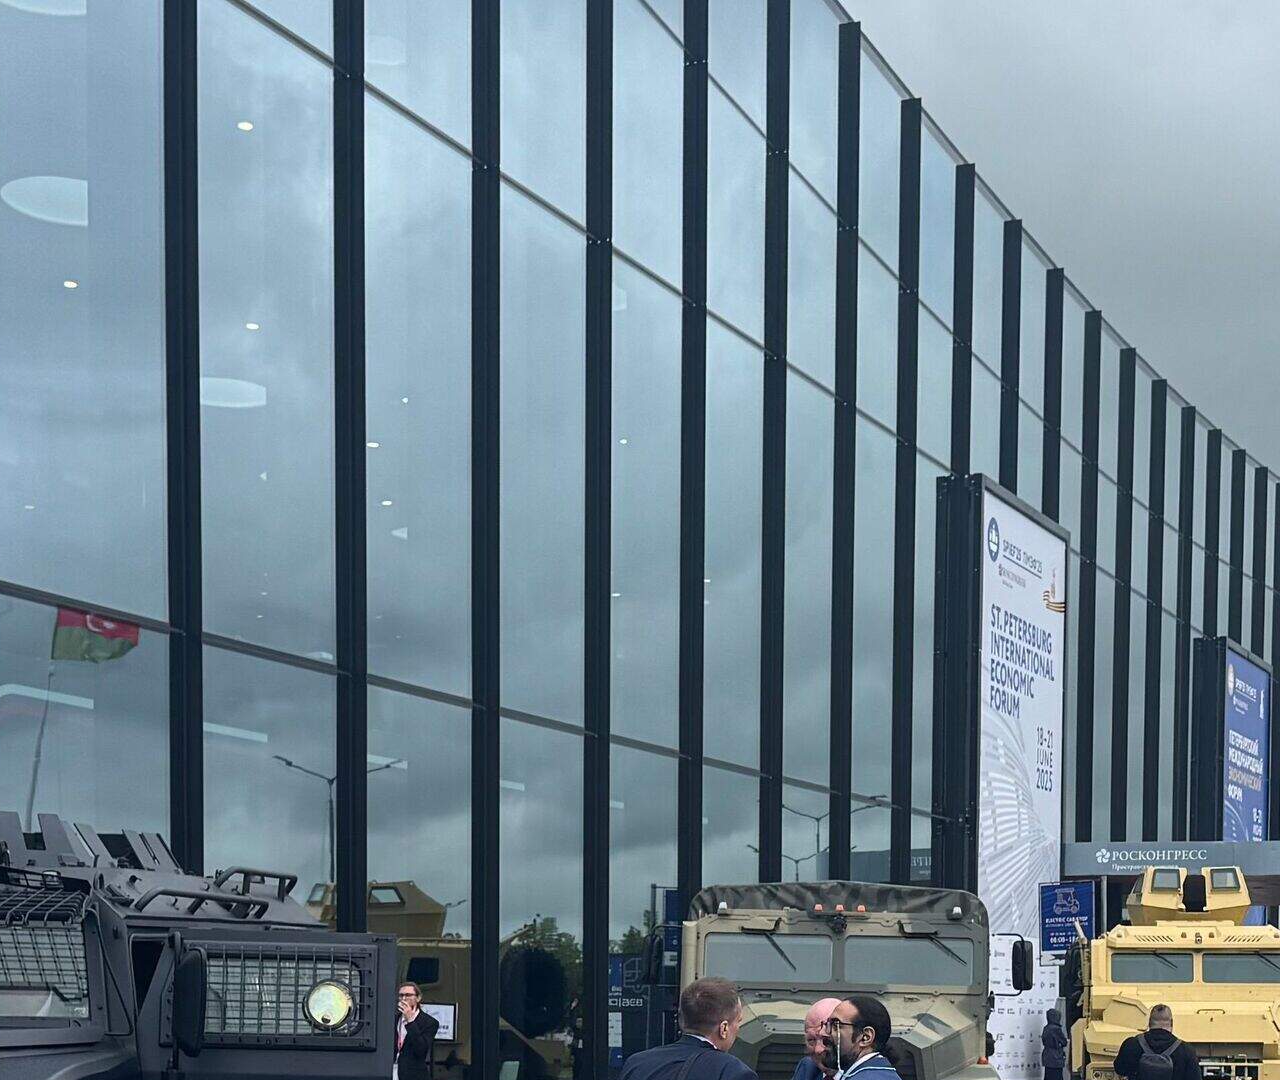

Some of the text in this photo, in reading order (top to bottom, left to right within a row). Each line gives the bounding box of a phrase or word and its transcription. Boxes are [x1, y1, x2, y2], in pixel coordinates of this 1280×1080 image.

[1004, 609, 1052, 655] PETERSBURG
[990, 631, 1055, 682] INTERNATIONAL
[990, 659, 1035, 698] ECONOMIC
[990, 685, 1020, 719] FORUM
[1036, 768, 1053, 792] 2025
[1112, 849, 1208, 861] РОСКОНГРЕСС
